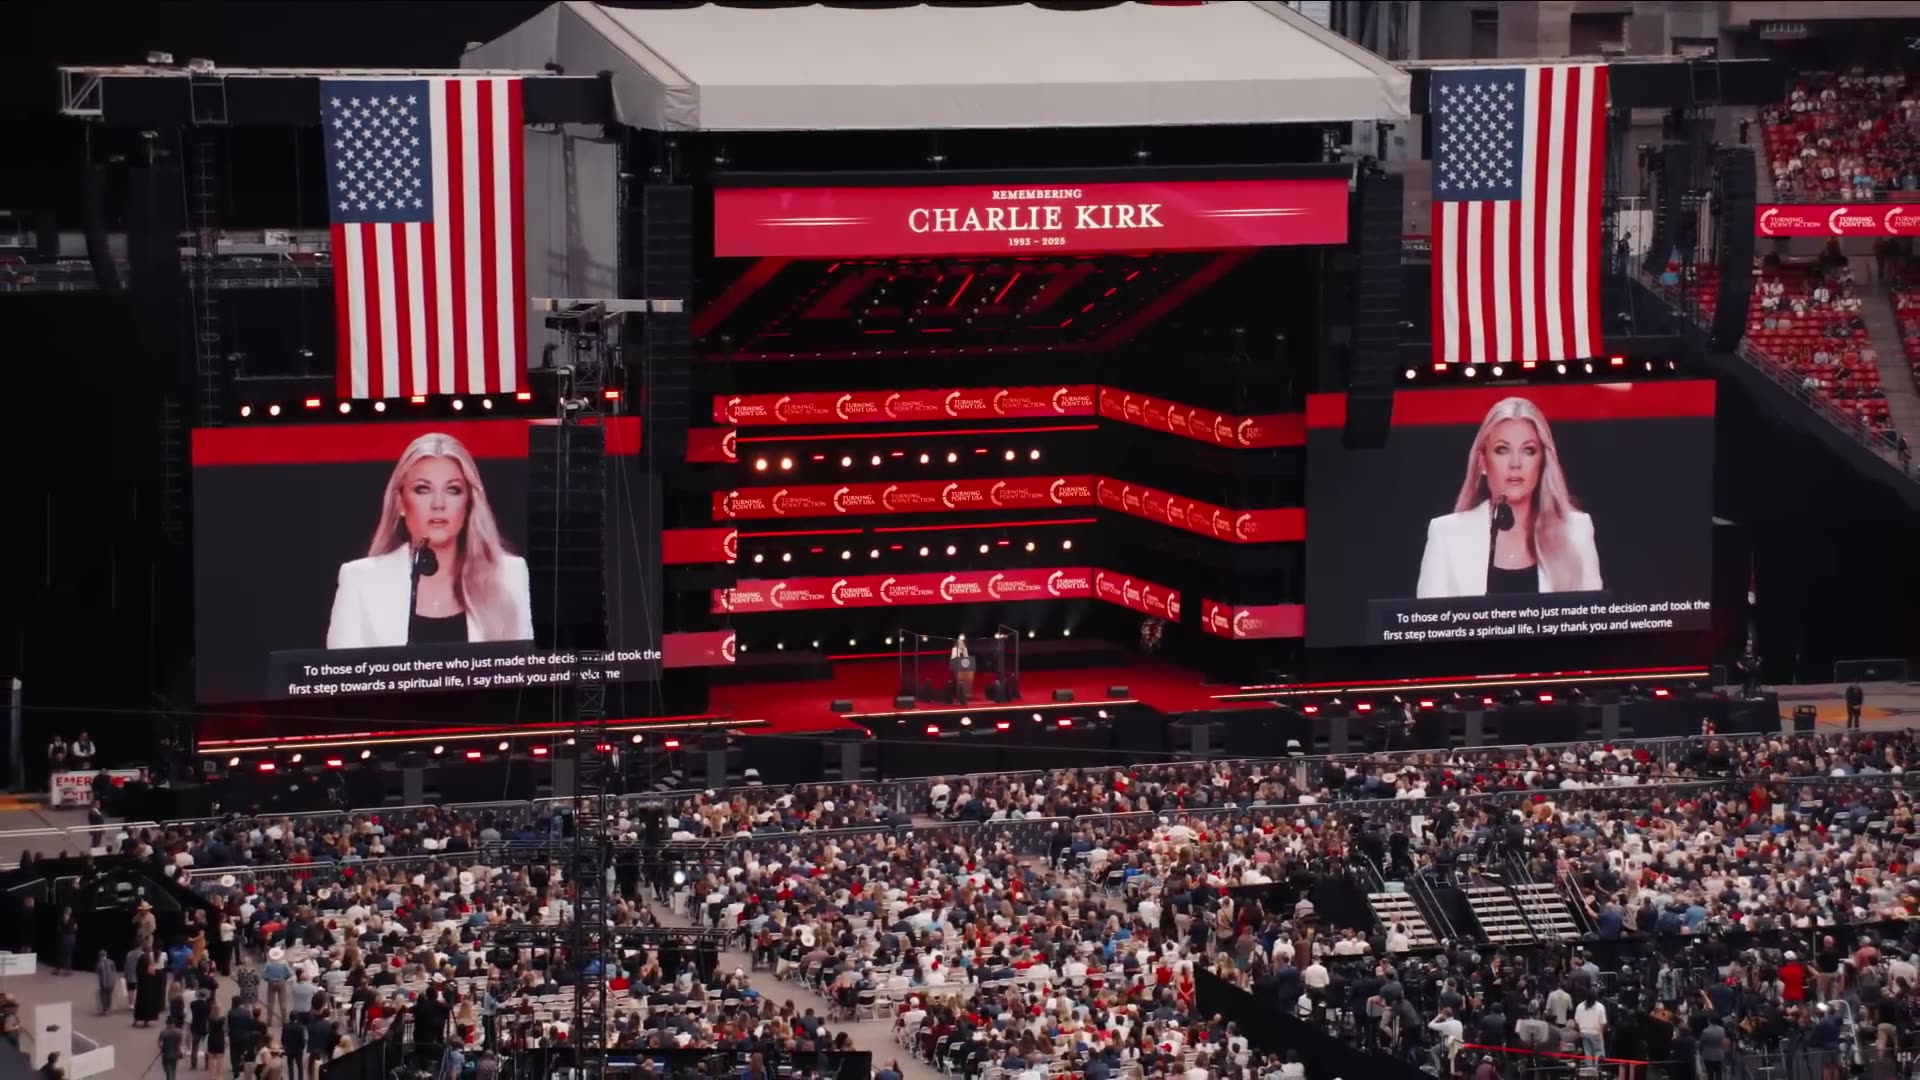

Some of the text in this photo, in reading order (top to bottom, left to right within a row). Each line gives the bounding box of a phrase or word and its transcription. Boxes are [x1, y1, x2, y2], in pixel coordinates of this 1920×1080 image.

[993, 189, 1082, 200] REMEMBERING
[908, 204, 1164, 233] CHARLIE KIRK
[1008, 237, 1030, 246] 1993
[1042, 237, 1066, 245] 2025
[1396, 599, 1710, 624] To those of you out there who just made the decision and took the
[1383, 618, 1673, 641] first step towards a spiritual life, I say thank you and welcome
[304, 665, 318, 676] To
[321, 664, 352, 675] those
[355, 662, 367, 674] of
[368, 663, 389, 676] you
[392, 661, 411, 672] out
[413, 659, 443, 671] there
[445, 658, 469, 669] who
[470, 657, 492, 671] just
[494, 655, 525, 667] made
[527, 654, 546, 665] the
[617, 650, 641, 661] took
[643, 649, 661, 660] the
[288, 683, 311, 695] first
[314, 682, 338, 696] step
[341, 680, 386, 692] towards
[388, 681, 395, 690] a
[397, 676, 442, 691] spiritual
[445, 675, 464, 687] life,
[466, 675, 471, 686] I
[473, 675, 491, 688] say
[494, 672, 525, 685] thank
[527, 673, 547, 686] you
[549, 670, 570, 682] and
